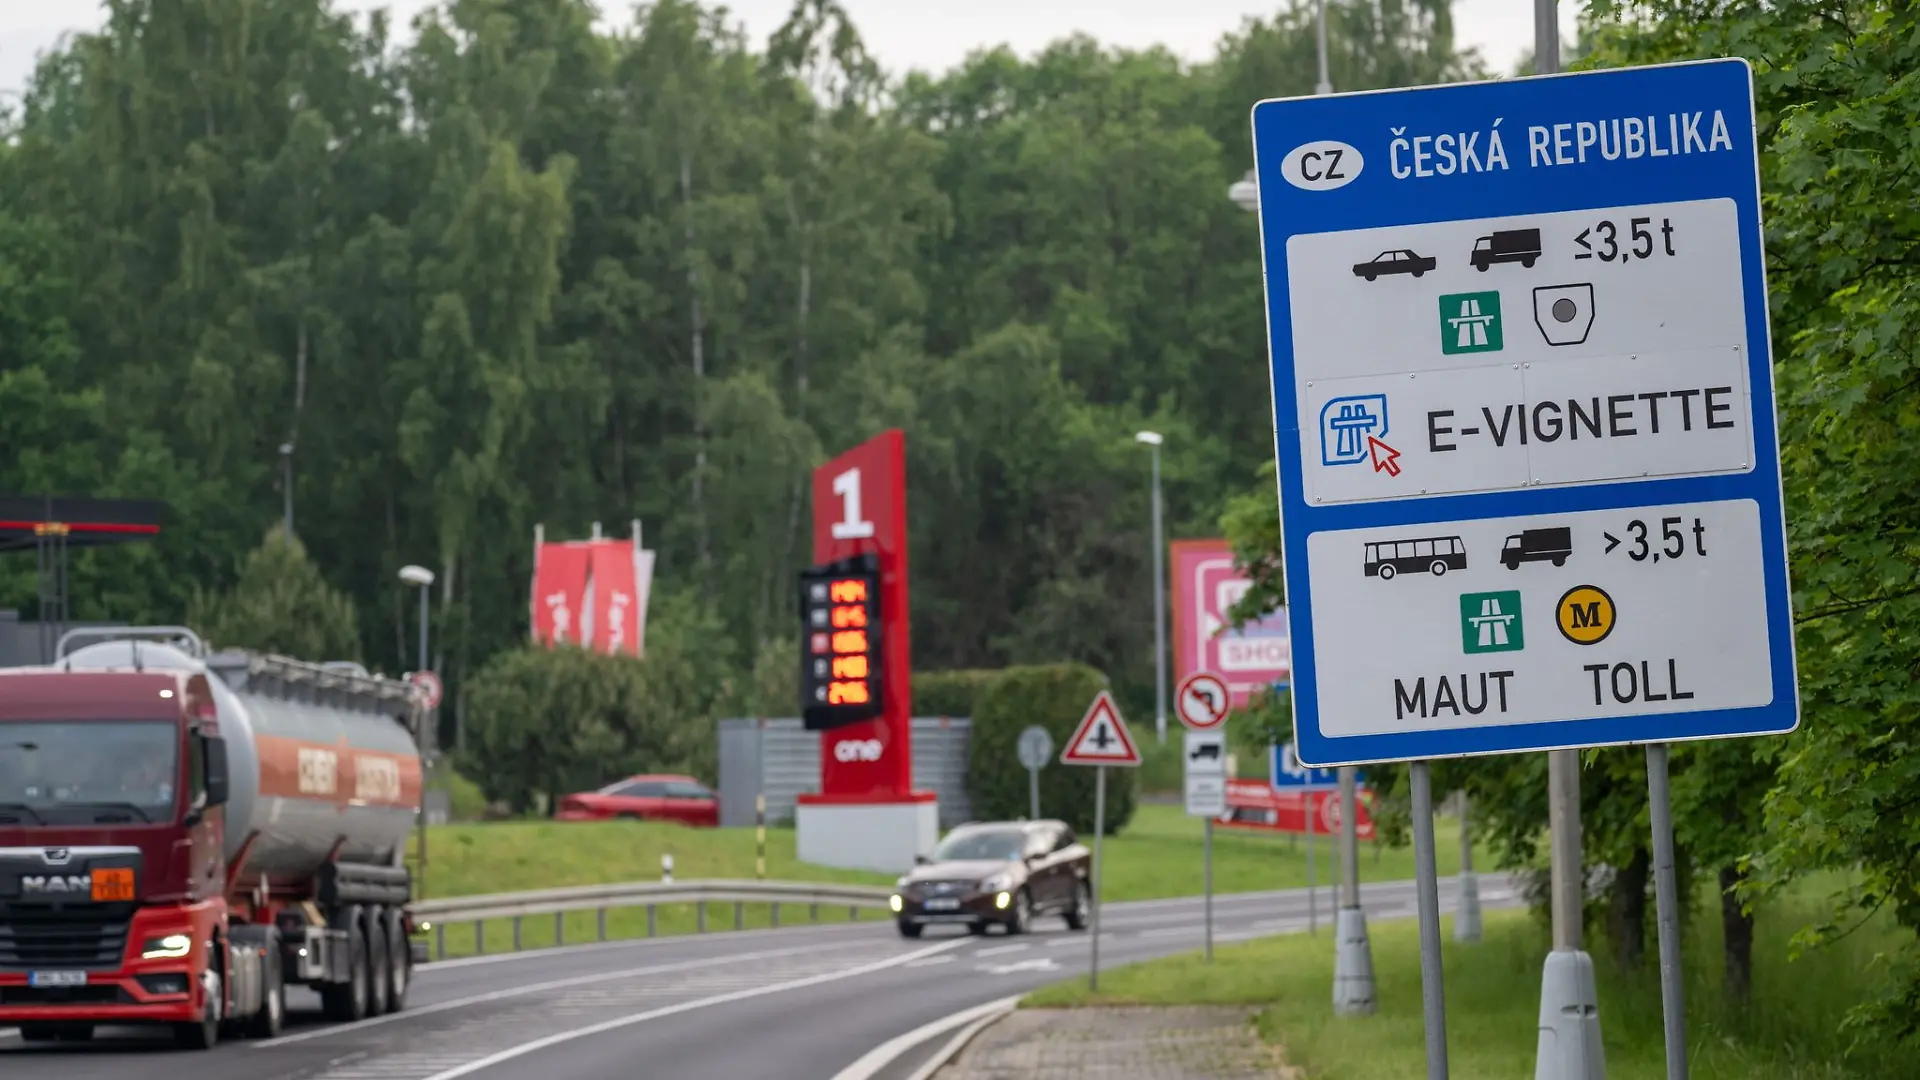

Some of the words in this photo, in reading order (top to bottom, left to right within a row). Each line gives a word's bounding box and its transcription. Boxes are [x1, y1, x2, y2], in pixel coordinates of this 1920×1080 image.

[1301, 150, 1345, 182] CZ
[1390, 117, 1509, 180] ČESKÁ
[1529, 109, 1733, 168] REPUBLIKA
[1427, 387, 1735, 453] E-VIGNETTE
[831, 468, 874, 539] 1
[1569, 601, 1603, 629] M
[1394, 670, 1514, 720] MAUT
[1583, 658, 1695, 706] TOLL
[835, 740, 882, 763] one
[22, 876, 91, 892] MAN
